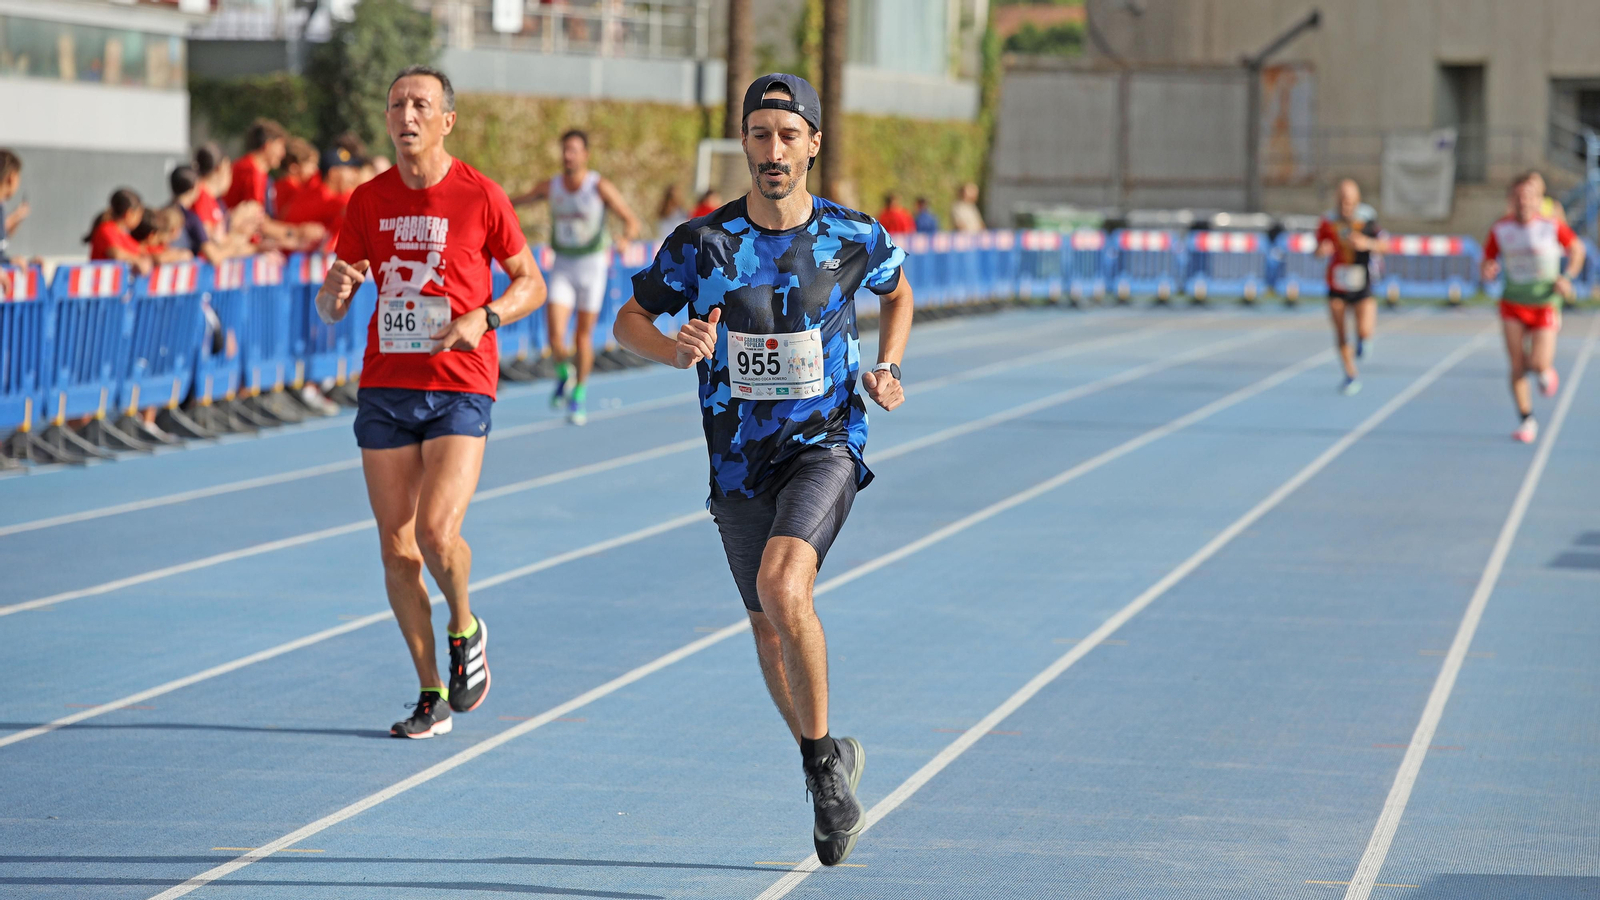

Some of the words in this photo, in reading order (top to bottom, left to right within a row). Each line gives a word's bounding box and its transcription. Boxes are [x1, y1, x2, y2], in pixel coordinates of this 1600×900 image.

[379, 218, 396, 231] XLII
[396, 215, 449, 232] CARRERA
[394, 228, 447, 243] POPULAR
[384, 312, 416, 332] 946
[738, 352, 780, 376] 955
